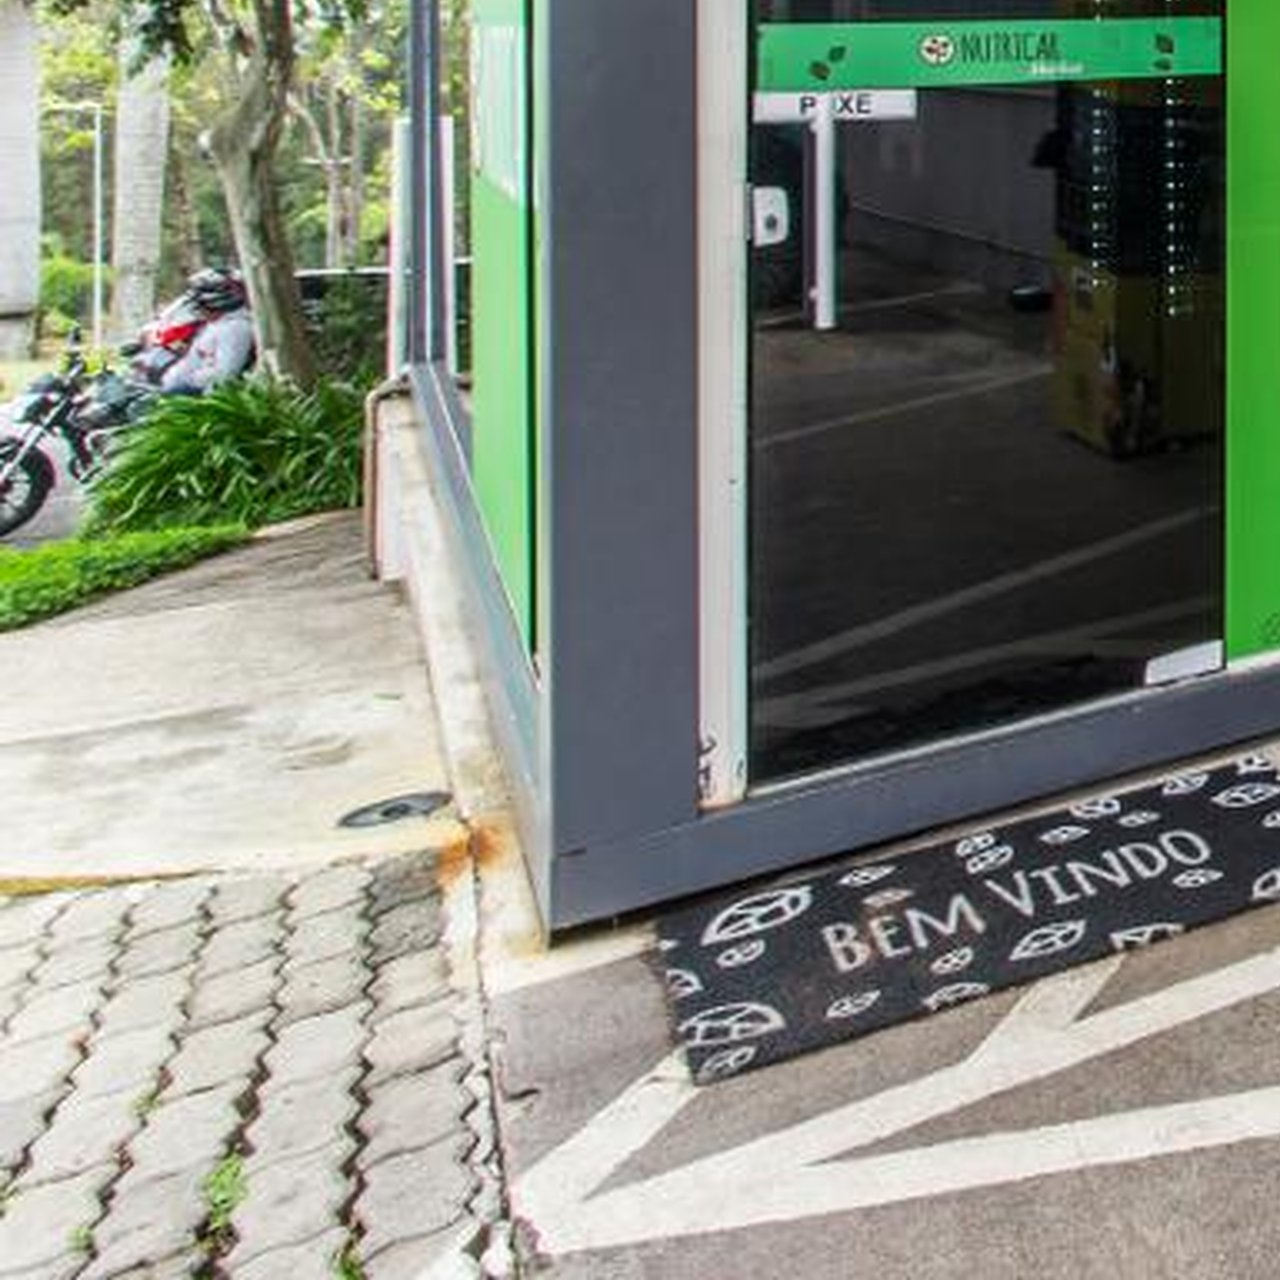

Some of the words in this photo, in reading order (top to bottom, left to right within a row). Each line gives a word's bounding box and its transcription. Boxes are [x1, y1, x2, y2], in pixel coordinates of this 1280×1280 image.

[799, 93, 873, 116] PXE
[818, 892, 989, 974] BEM
[985, 828, 1213, 919] VINDO
